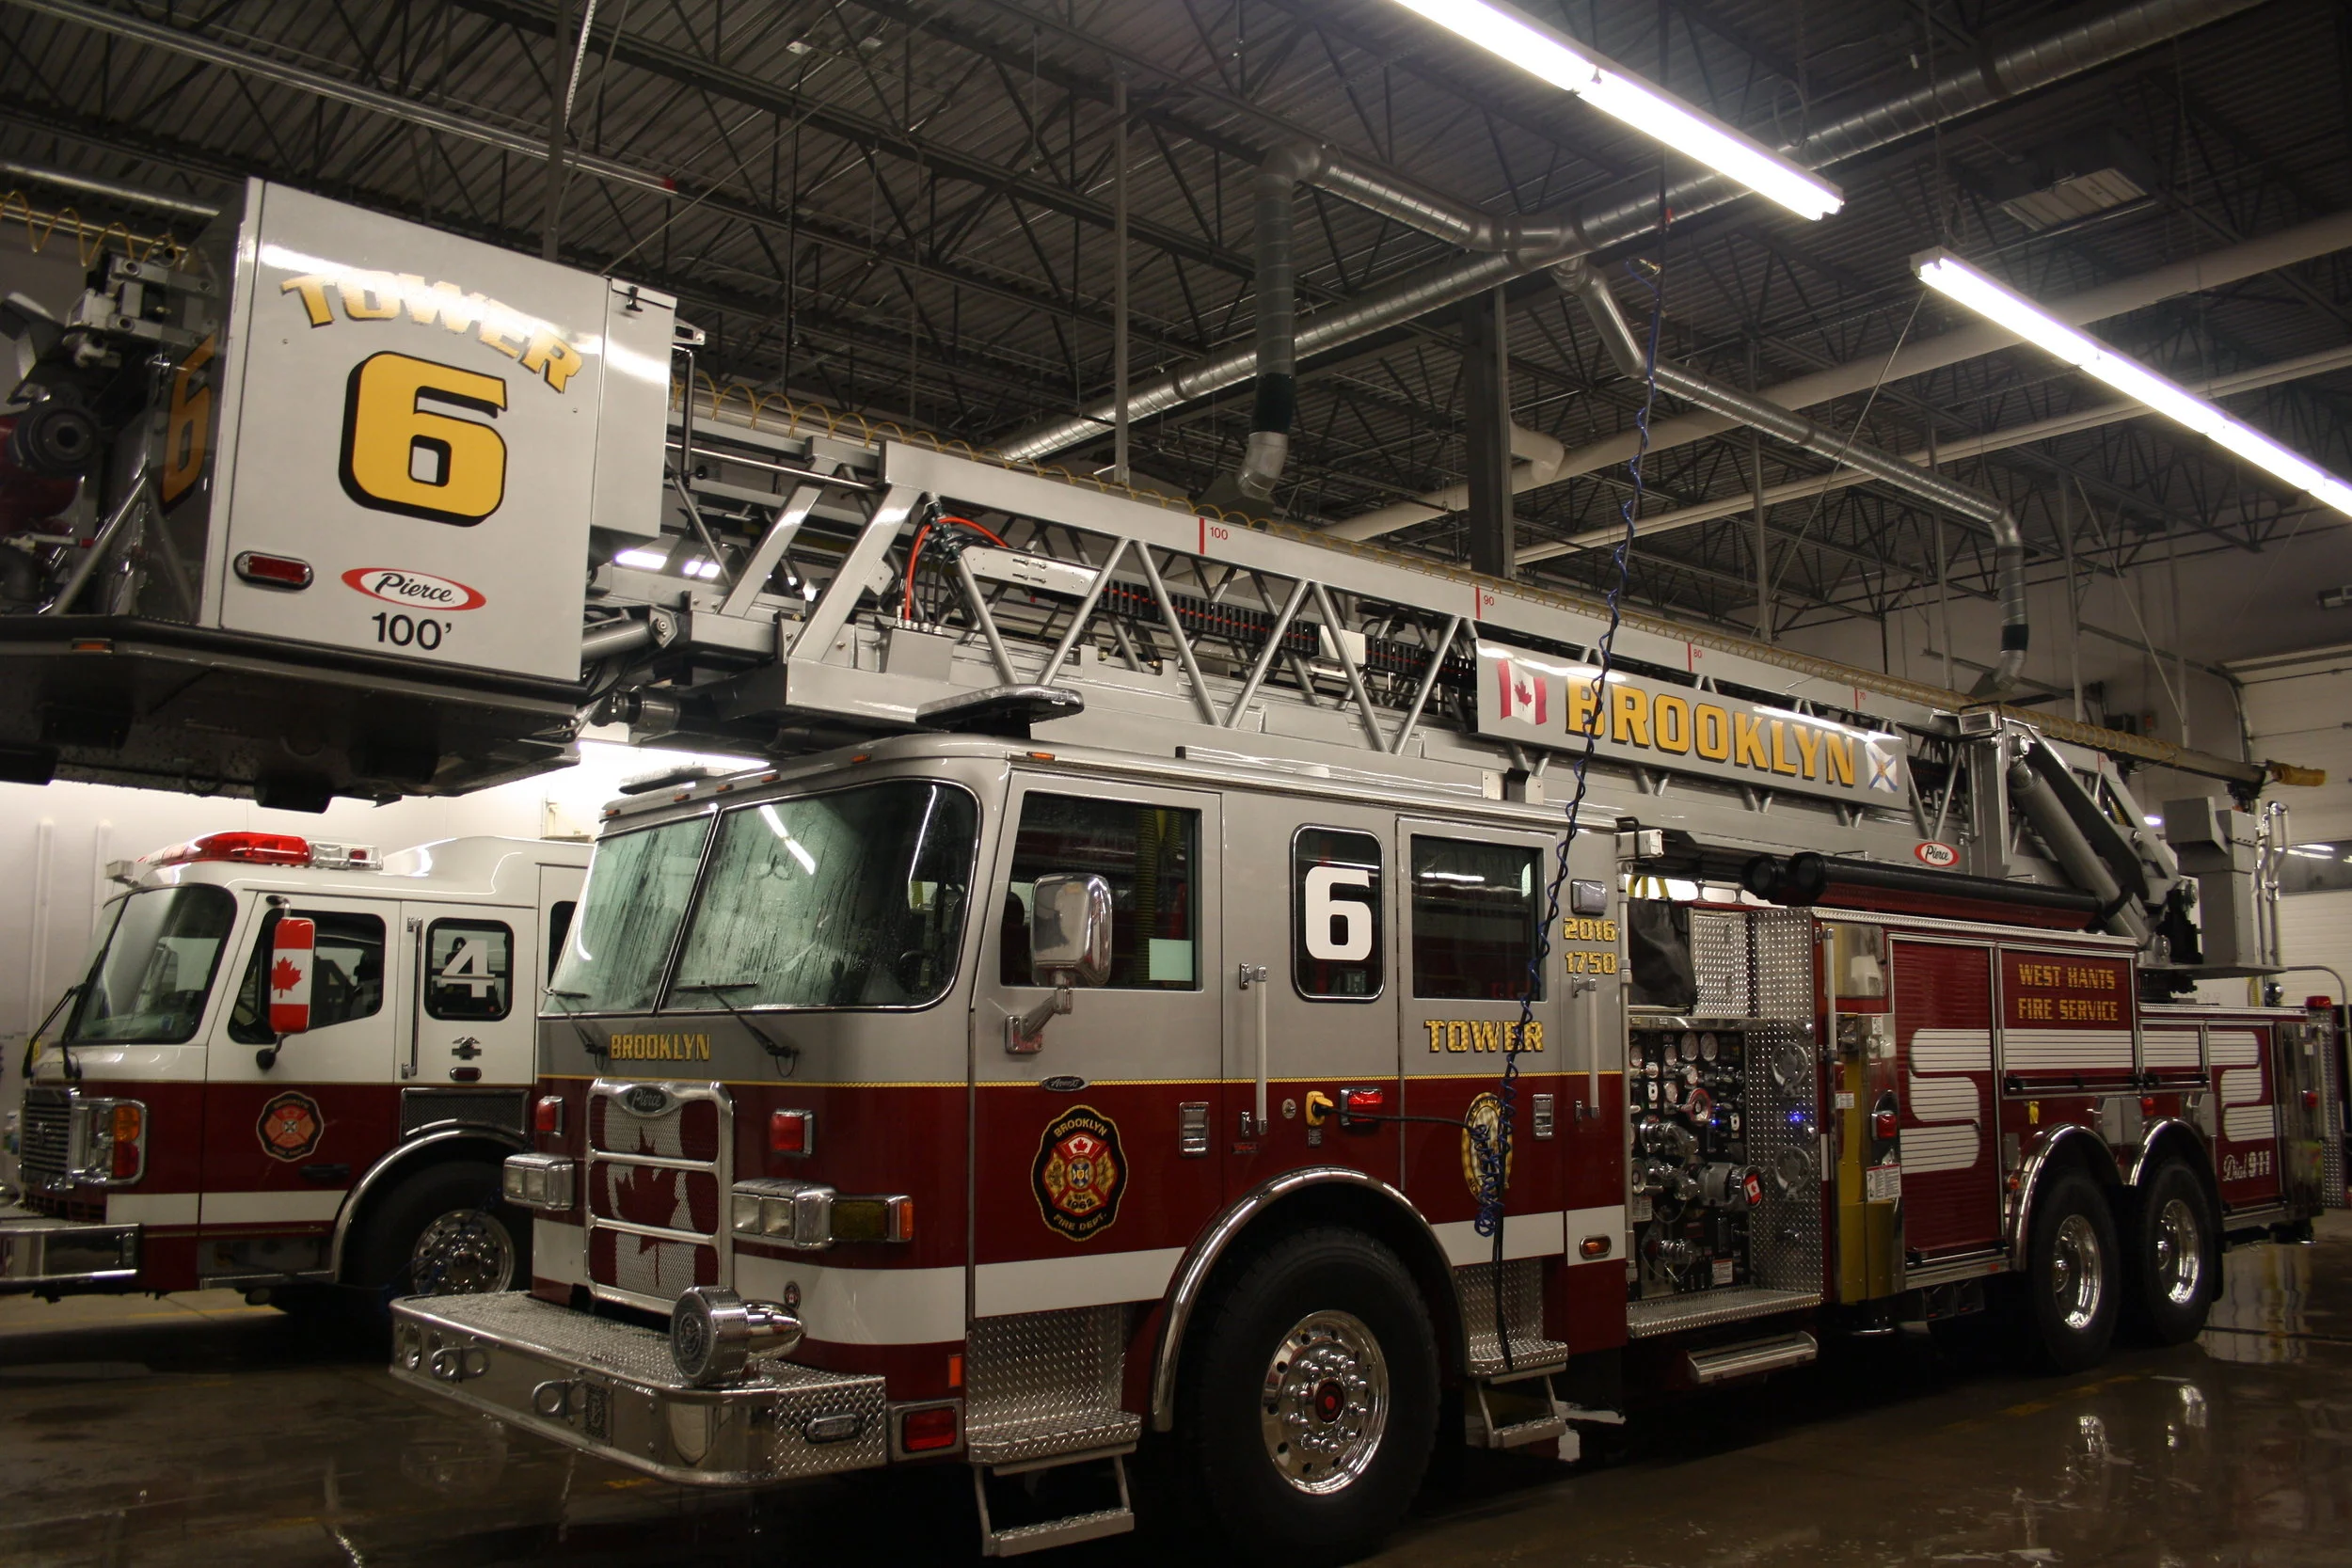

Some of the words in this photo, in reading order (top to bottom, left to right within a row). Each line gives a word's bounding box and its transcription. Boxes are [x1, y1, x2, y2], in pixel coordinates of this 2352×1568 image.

[280, 271, 583, 394] TOWER
[339, 351, 508, 528] 6
[1209, 526, 1229, 541] 100
[374, 571, 454, 604] Pierce
[1483, 594, 1495, 607] 90
[372, 612, 453, 650] 100'
[1693, 648, 1703, 658] 80
[1565, 673, 1855, 787] BROOKLYN
[1925, 845, 1949, 863] Pierce
[1304, 865, 1373, 961] 6
[1563, 917, 1617, 942] 2016
[440, 939, 496, 998] 4
[1565, 951, 1617, 974] 1750
[2018, 963, 2061, 987] WEST
[2067, 967, 2116, 990] HANTS
[2018, 997, 2053, 1020] FIRE
[2058, 999, 2119, 1022] SERVICE
[610, 1033, 711, 1061] BROOKLYN
[1423, 1020, 1544, 1053] TOWER
[631, 1088, 661, 1108] Pierce
[1053, 1117, 1108, 1138] BROOKLYN
[1067, 1198, 1094, 1210] 1962
[1053, 1213, 1076, 1230] FIRE
